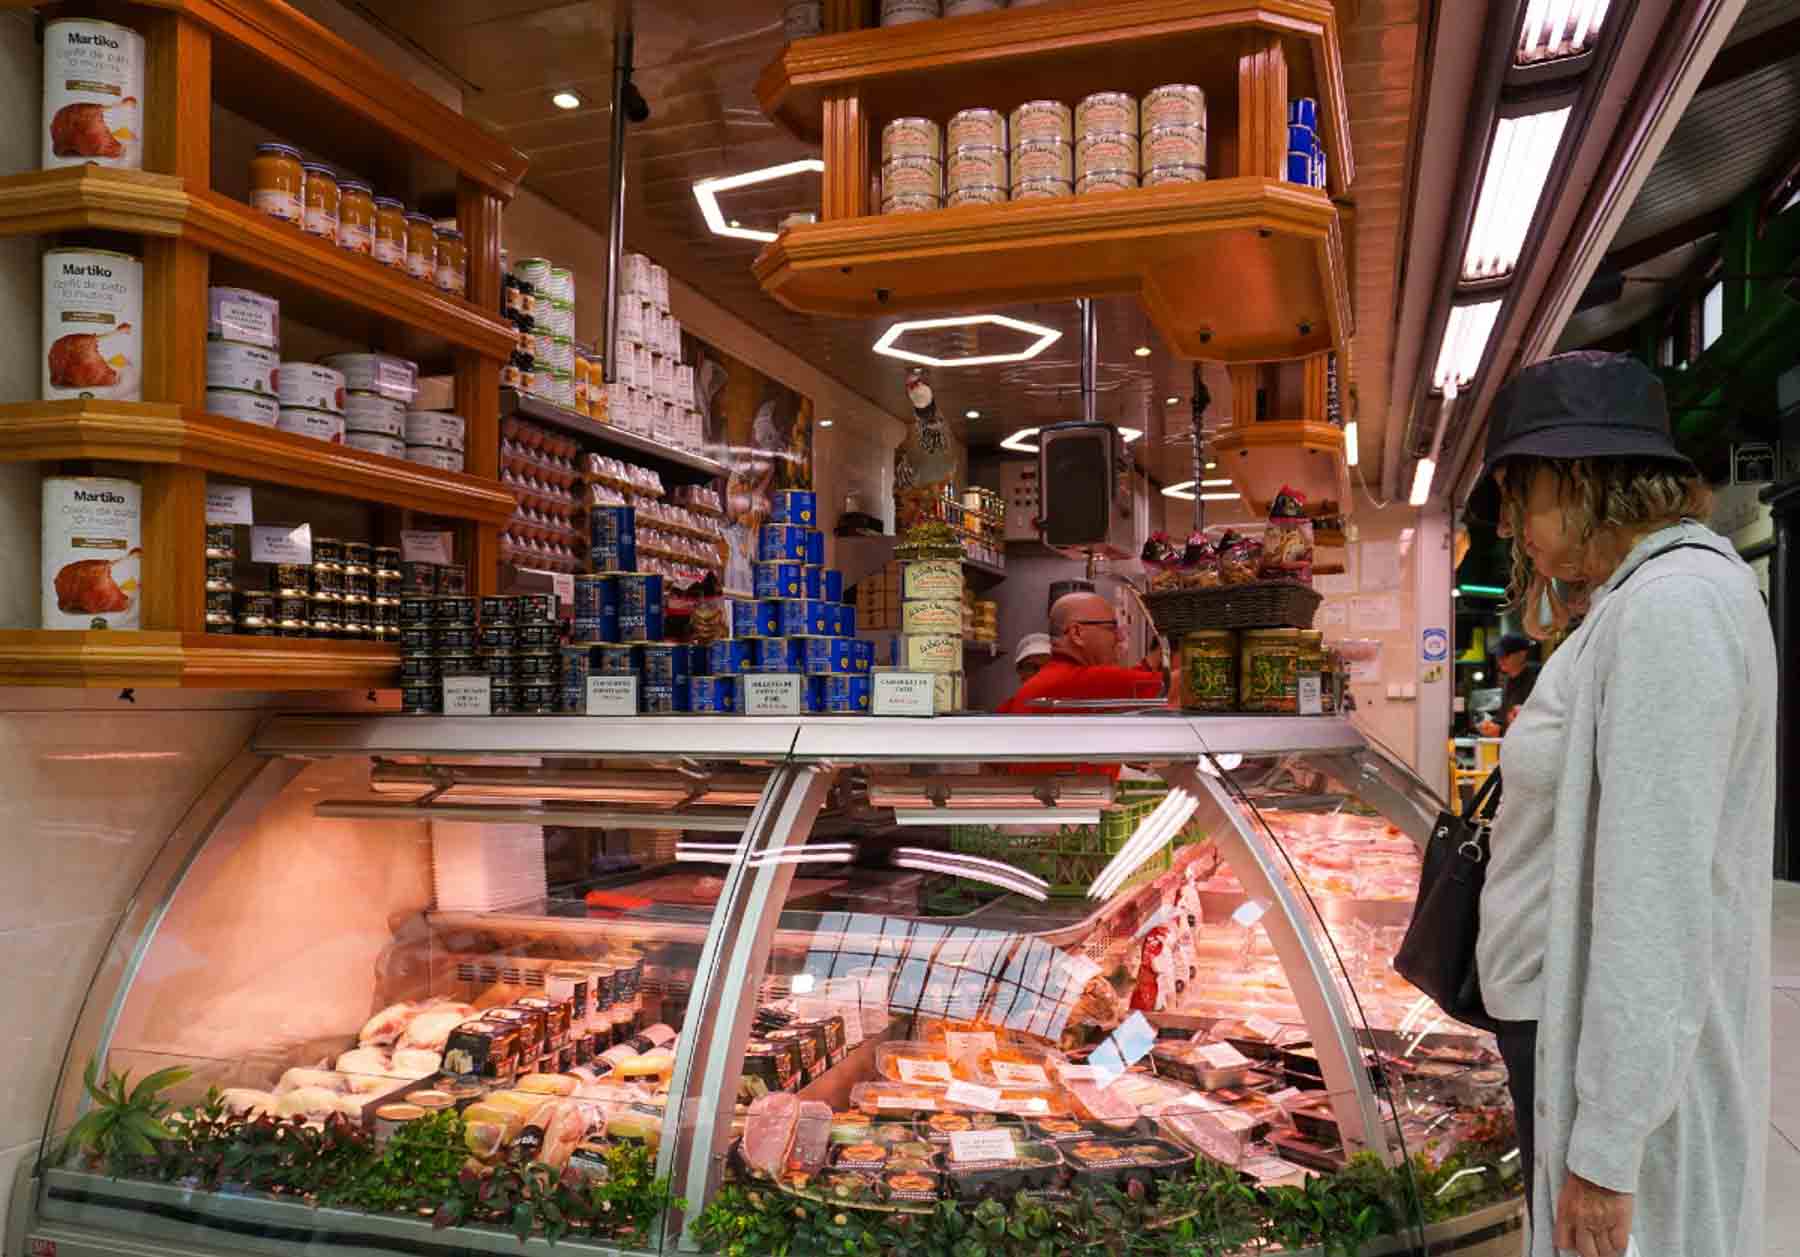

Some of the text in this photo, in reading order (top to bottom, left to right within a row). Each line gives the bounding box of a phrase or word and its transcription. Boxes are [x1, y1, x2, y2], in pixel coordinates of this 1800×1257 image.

[68, 32, 119, 49] Martiko
[62, 263, 112, 278] Martiko
[73, 489, 125, 504] Martiko
